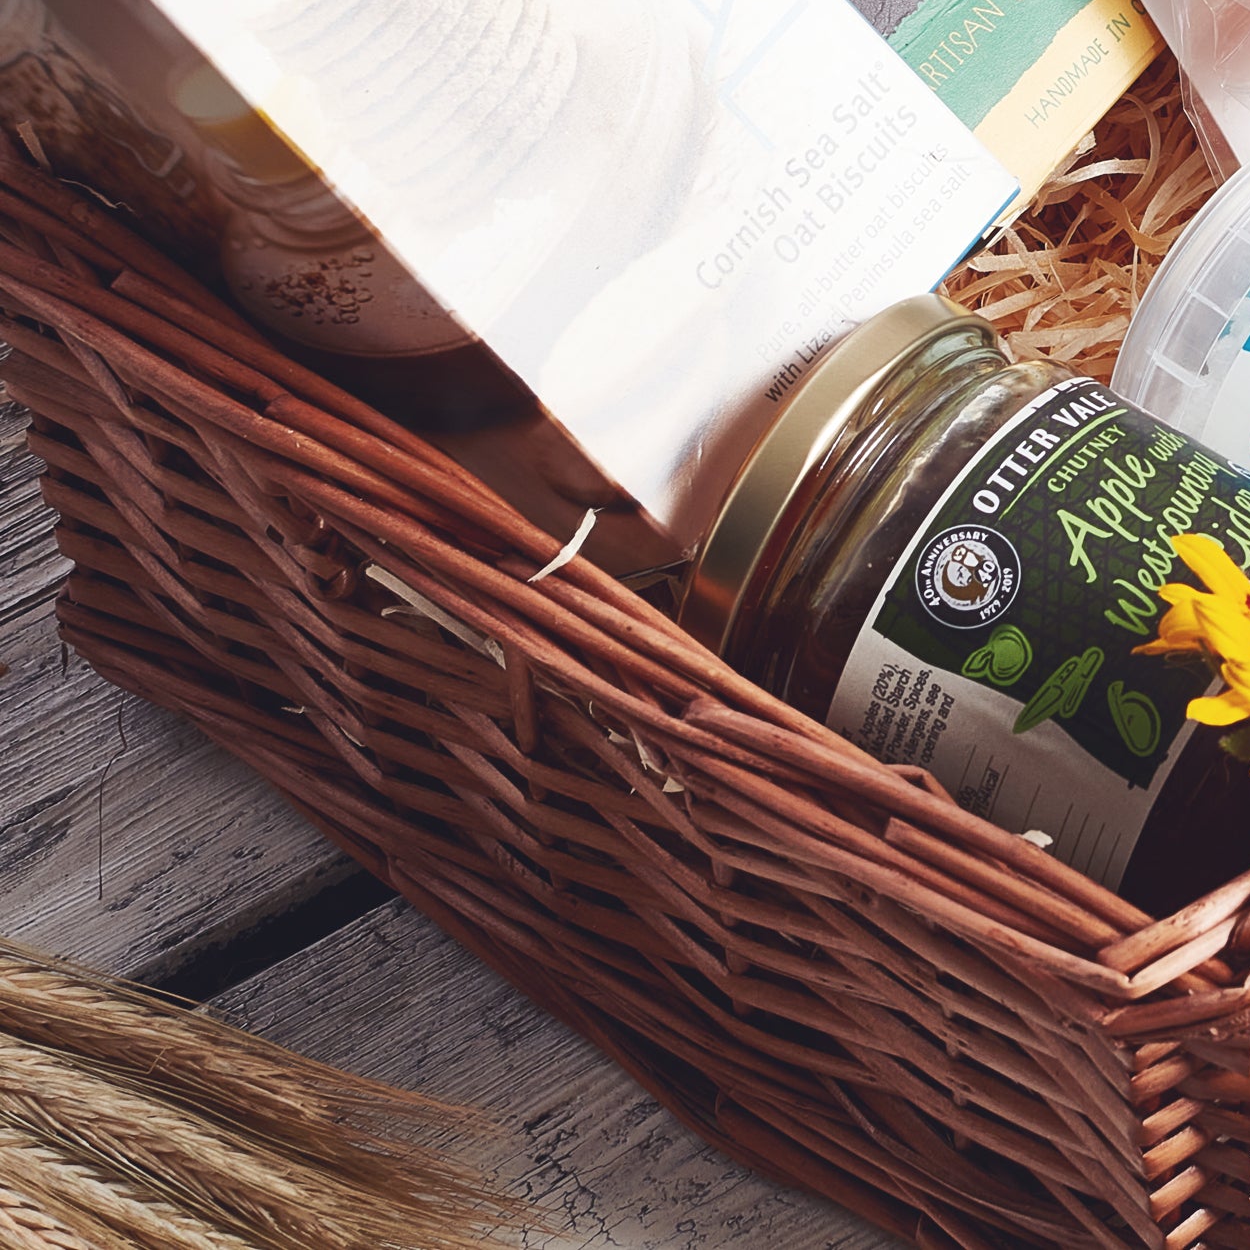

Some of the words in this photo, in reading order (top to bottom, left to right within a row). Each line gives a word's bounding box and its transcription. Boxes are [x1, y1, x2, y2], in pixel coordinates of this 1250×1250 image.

[1024, 38, 1109, 128] HANDMADE
[1106, 13, 1131, 43] IN
[695, 185, 793, 290] Cornish
[784, 136, 840, 187] Sea
[772, 213, 827, 265] Oat
[815, 103, 918, 214] Biscuits
[865, 210, 895, 240] oat
[894, 143, 949, 210] biscuits
[765, 366, 802, 403] with
[803, 307, 849, 364] Lizard
[839, 233, 914, 307] Peninsula
[912, 201, 942, 231] sea
[939, 164, 972, 200] salt
[972, 427, 1061, 515] OTTER
[1052, 390, 1117, 433] VALE
[1047, 424, 1127, 493] CHUTNEY
[1057, 453, 1156, 583] Apple
[1150, 426, 1188, 467] with
[1104, 449, 1224, 636] Westcountry
[921, 531, 988, 577] ANNIVERSARY
[978, 561, 996, 583] 40
[979, 599, 1001, 620] 1979
[1001, 567, 1013, 593] 2019
[888, 669, 912, 708] Starch
[903, 669, 933, 710] Spices,
[920, 718, 947, 763] opening
[938, 693, 955, 720] and
[926, 684, 942, 706] see
